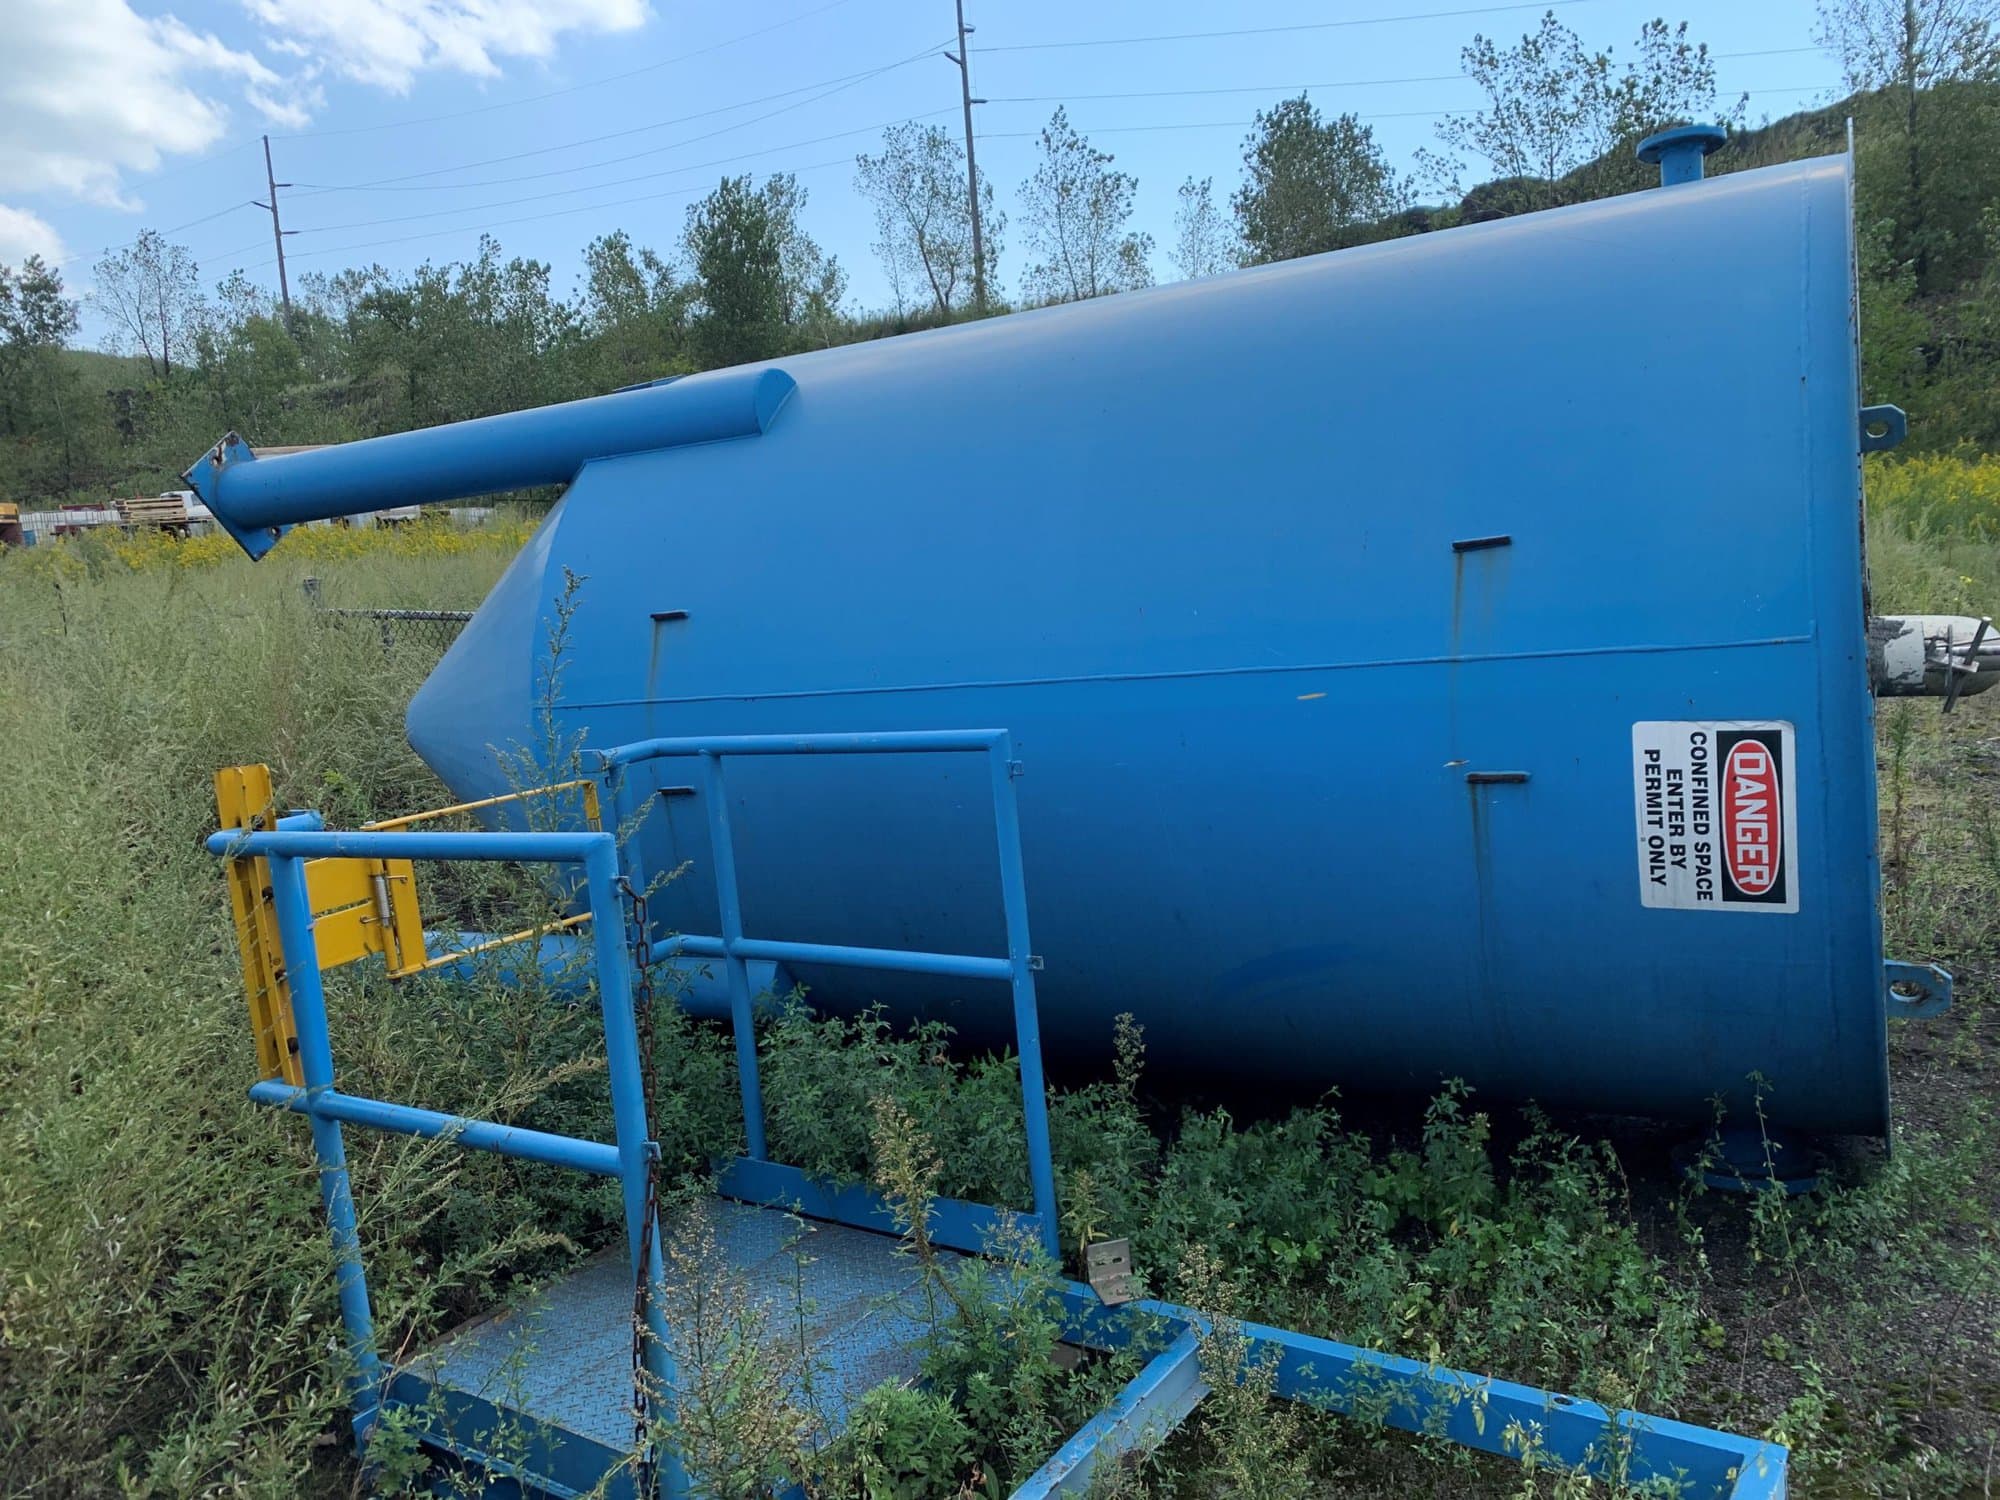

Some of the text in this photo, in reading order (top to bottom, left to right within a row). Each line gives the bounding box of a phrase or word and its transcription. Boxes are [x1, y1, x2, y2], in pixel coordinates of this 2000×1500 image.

[1644, 749, 1667, 886] PERMIT ONLY
[1666, 769, 1687, 870] ENTER BY
[1690, 732, 1713, 901] CONFINED SPACE
[1734, 752, 1770, 886] DANGER
